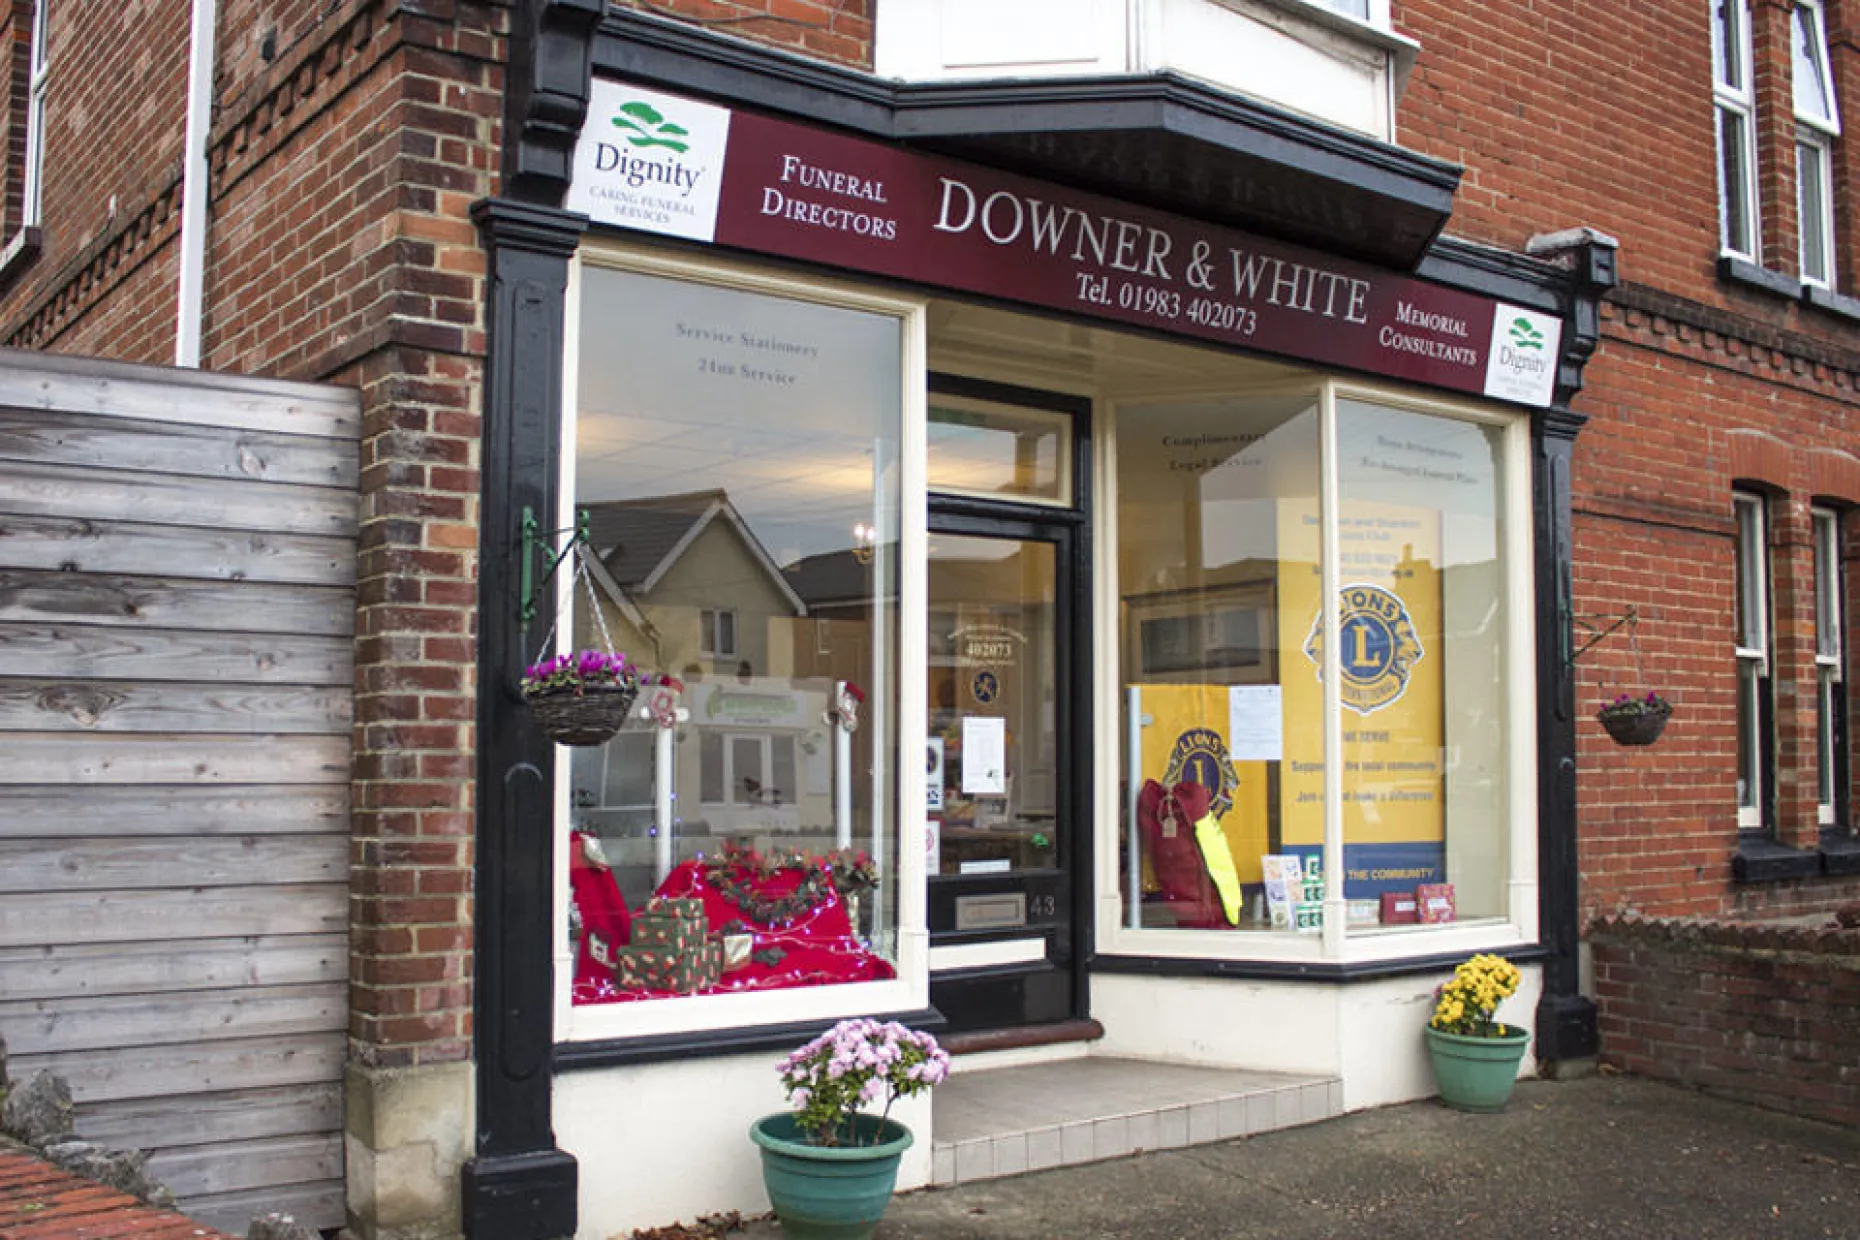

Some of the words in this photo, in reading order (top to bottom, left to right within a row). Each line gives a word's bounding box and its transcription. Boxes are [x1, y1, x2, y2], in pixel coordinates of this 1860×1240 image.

[595, 142, 702, 197] Dignity
[781, 154, 888, 203] FUNERAL
[760, 187, 897, 241] DIRECTORS
[932, 176, 1172, 281] DOWNER
[1185, 239, 1216, 292] &
[1228, 247, 1371, 325] WHITE
[1076, 272, 1112, 306] Tel.
[1119, 282, 1181, 319] 01983
[1186, 293, 1257, 336] 402073
[1395, 300, 1469, 338] MEMORIAL
[676, 322, 733, 343] Service
[740, 332, 818, 360] Stationery
[1379, 325, 1478, 366] CONSULTANTS
[741, 363, 797, 385] Service
[1351, 625, 1381, 667] L
[1347, 869, 1368, 880] THE
[1370, 867, 1433, 880] COMMUNITY
